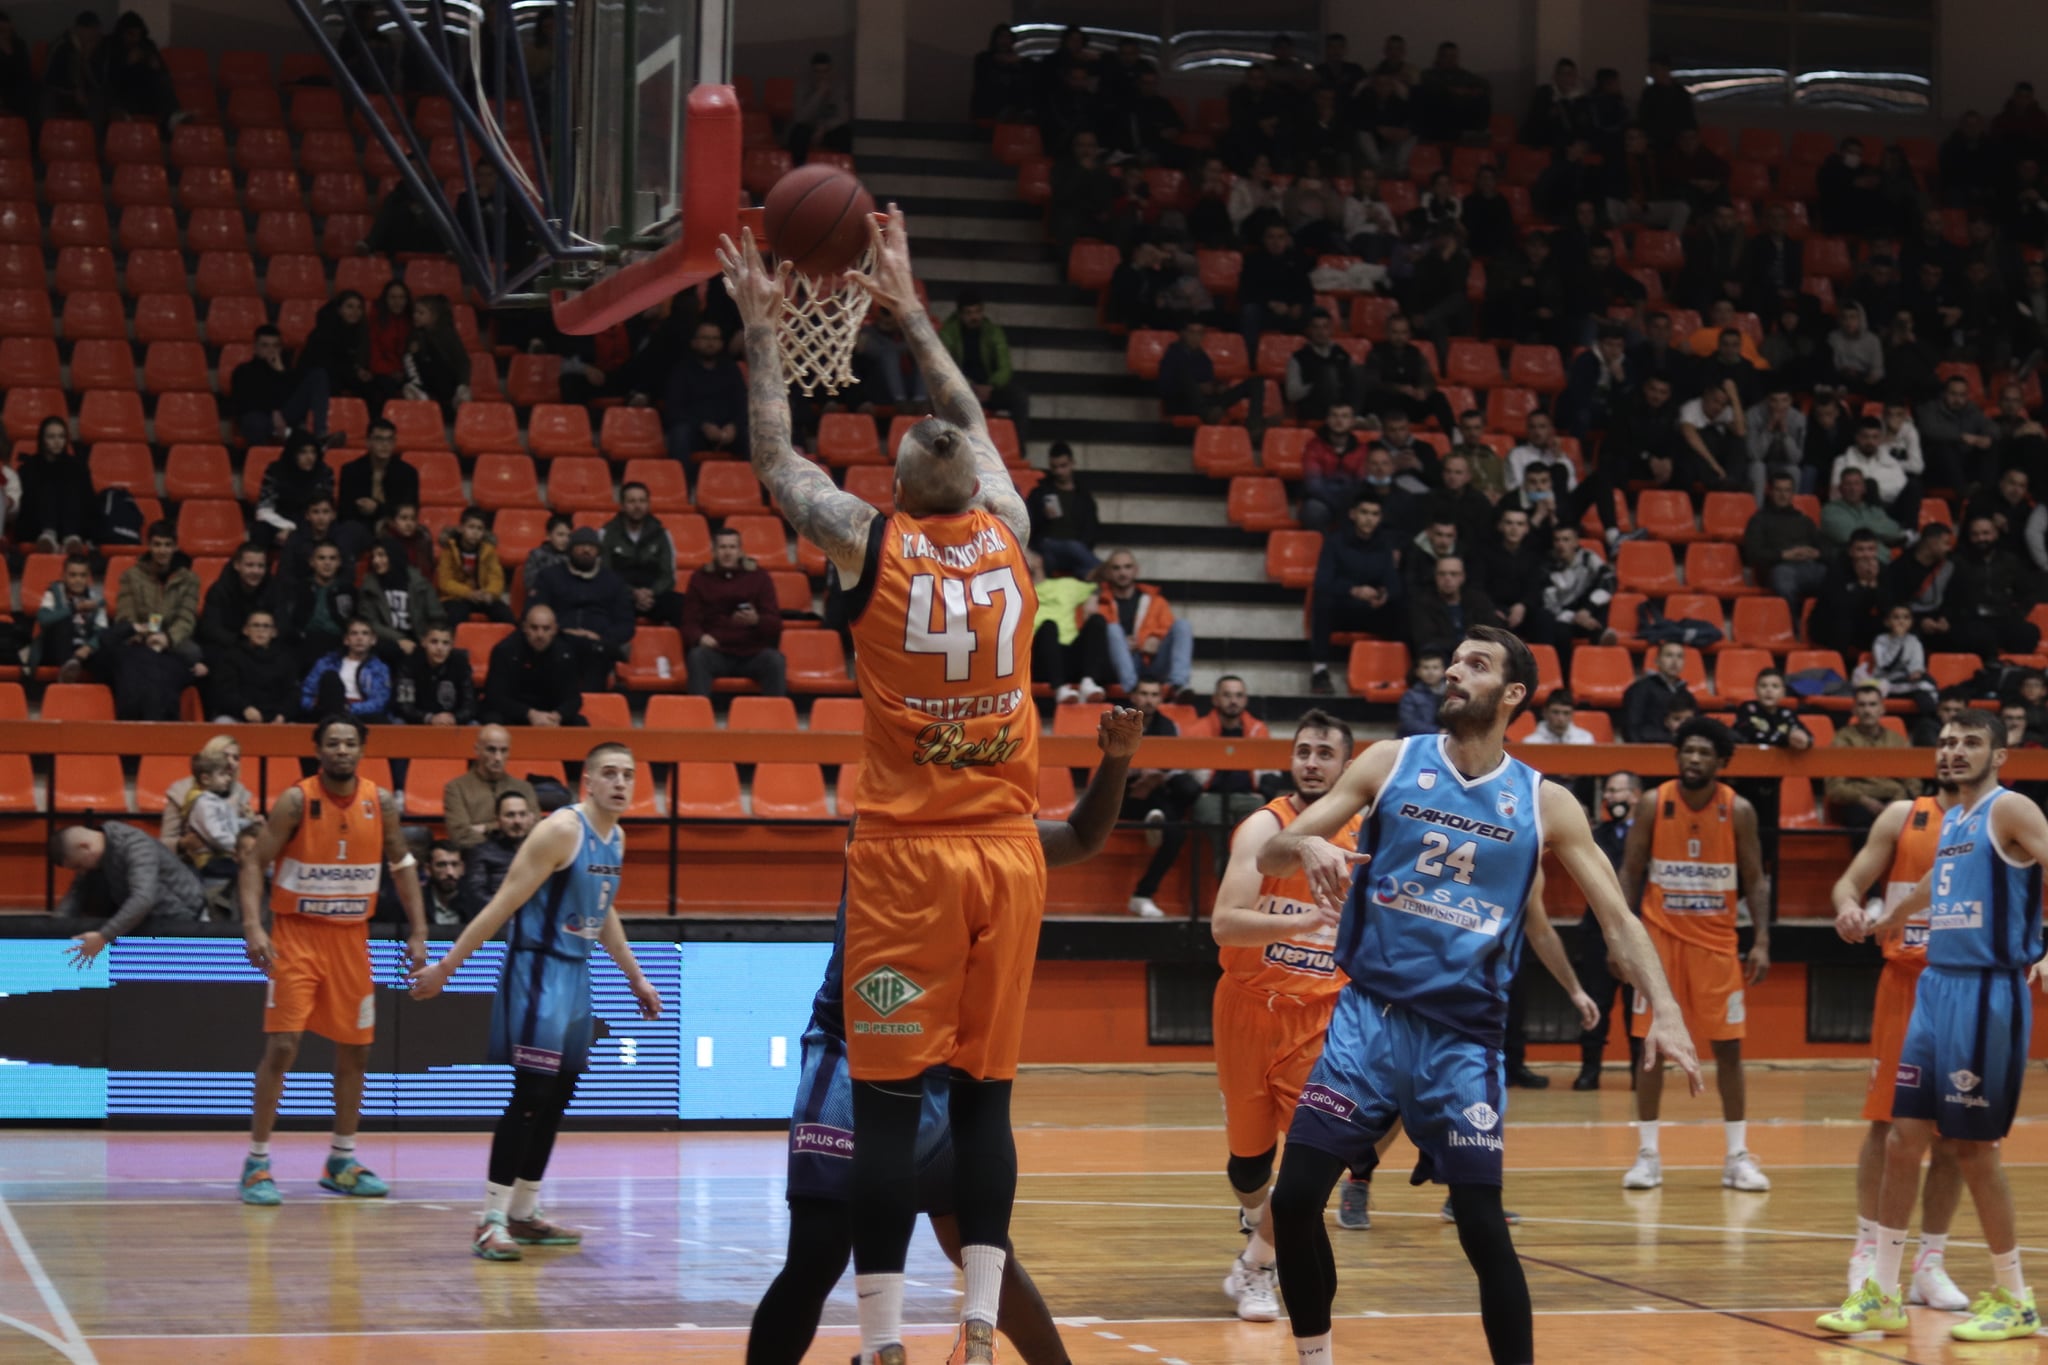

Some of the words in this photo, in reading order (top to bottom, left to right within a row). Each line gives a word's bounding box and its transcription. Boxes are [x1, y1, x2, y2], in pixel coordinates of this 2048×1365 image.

[904, 566, 1023, 682] 47
[1399, 803, 1516, 843] RAHOVECI
[336, 840, 347, 860] 1
[1415, 831, 1478, 885] 24
[298, 867, 376, 880] LAMBARIO
[1937, 862, 1955, 896] 5
[854, 1022, 869, 1034] HIB
[872, 1022, 924, 1034] PETROL
[806, 1132, 833, 1147] PLUS
